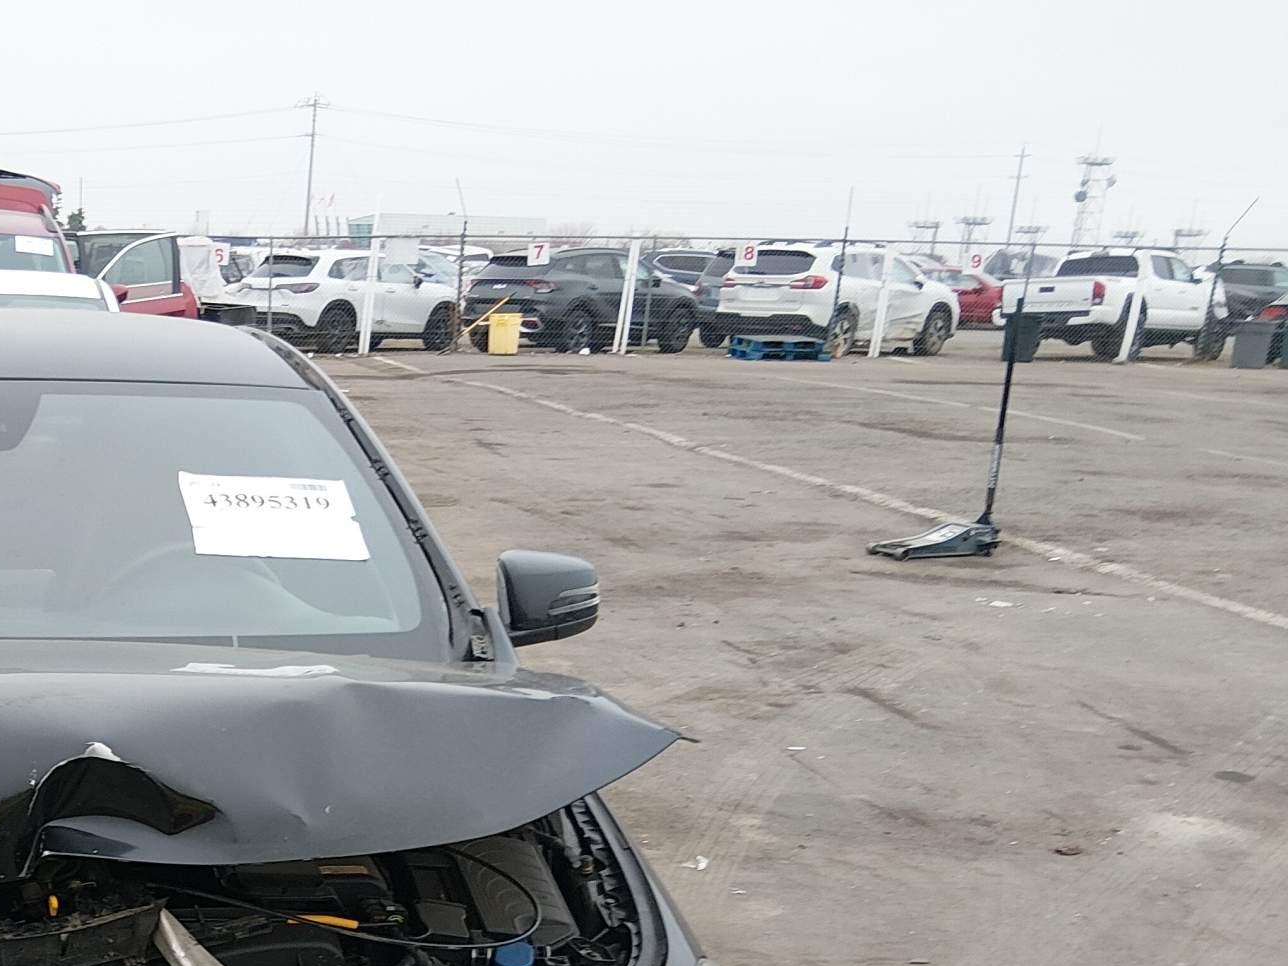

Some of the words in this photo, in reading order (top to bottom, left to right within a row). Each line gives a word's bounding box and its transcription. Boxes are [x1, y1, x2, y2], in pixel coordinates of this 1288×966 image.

[534, 245, 544, 260] 7
[744, 246, 754, 260] 8
[972, 254, 982, 268] 9
[203, 493, 330, 510] 43895319
